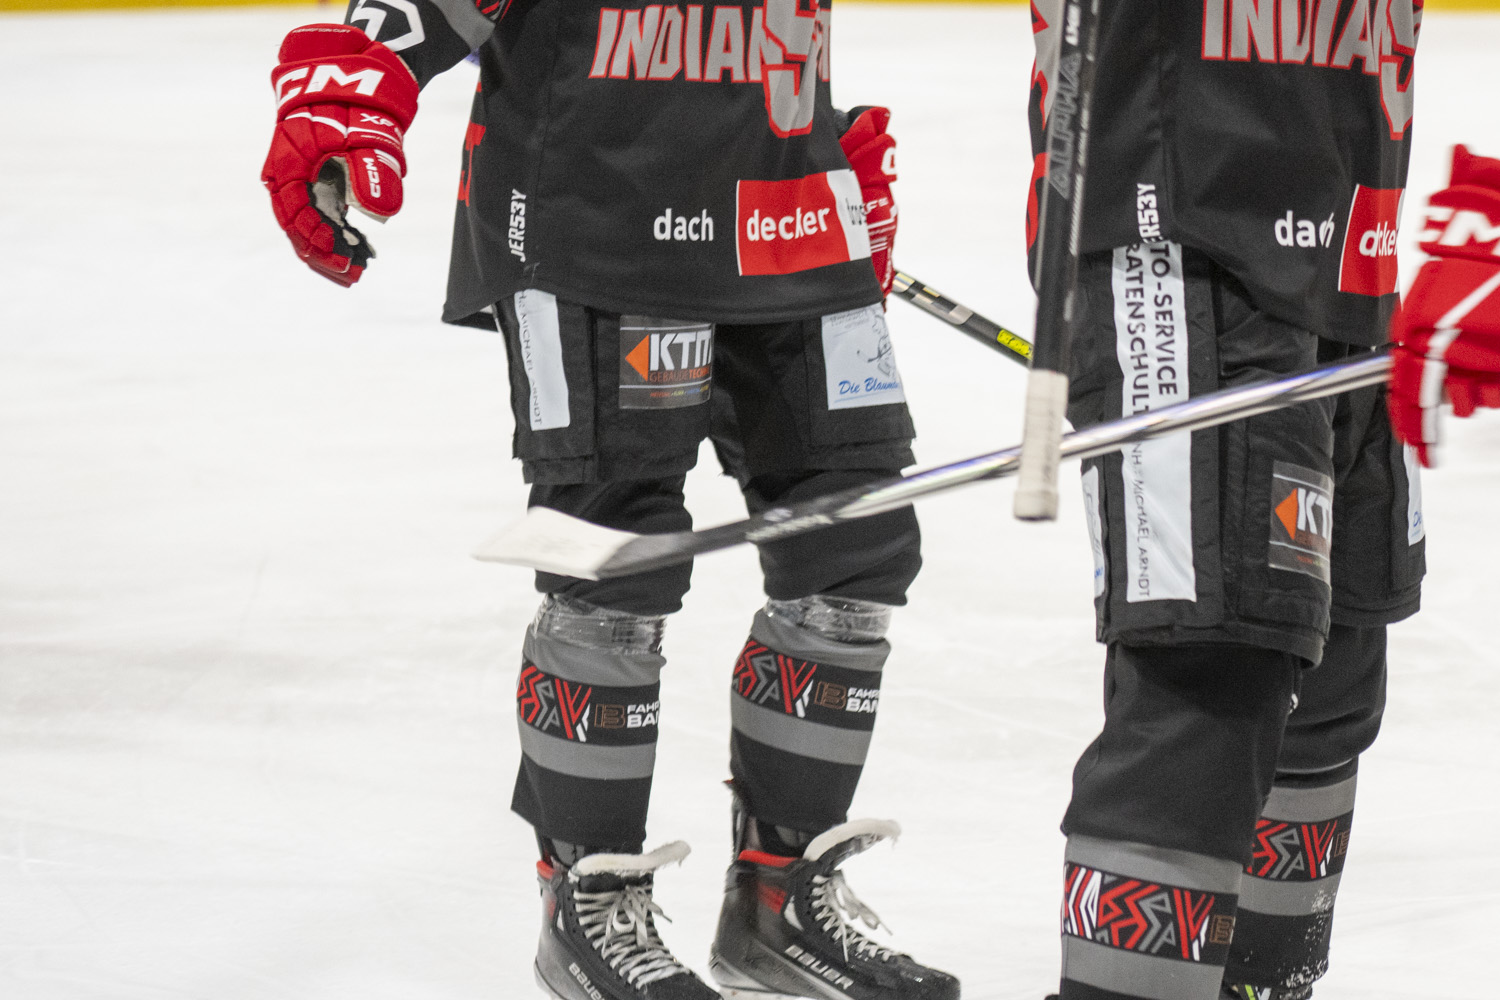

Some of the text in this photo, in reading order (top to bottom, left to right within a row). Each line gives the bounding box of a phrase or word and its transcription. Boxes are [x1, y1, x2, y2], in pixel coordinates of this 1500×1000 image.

[362, 157, 382, 199] CCM
[653, 208, 714, 242] dach
[746, 207, 830, 242] decker
